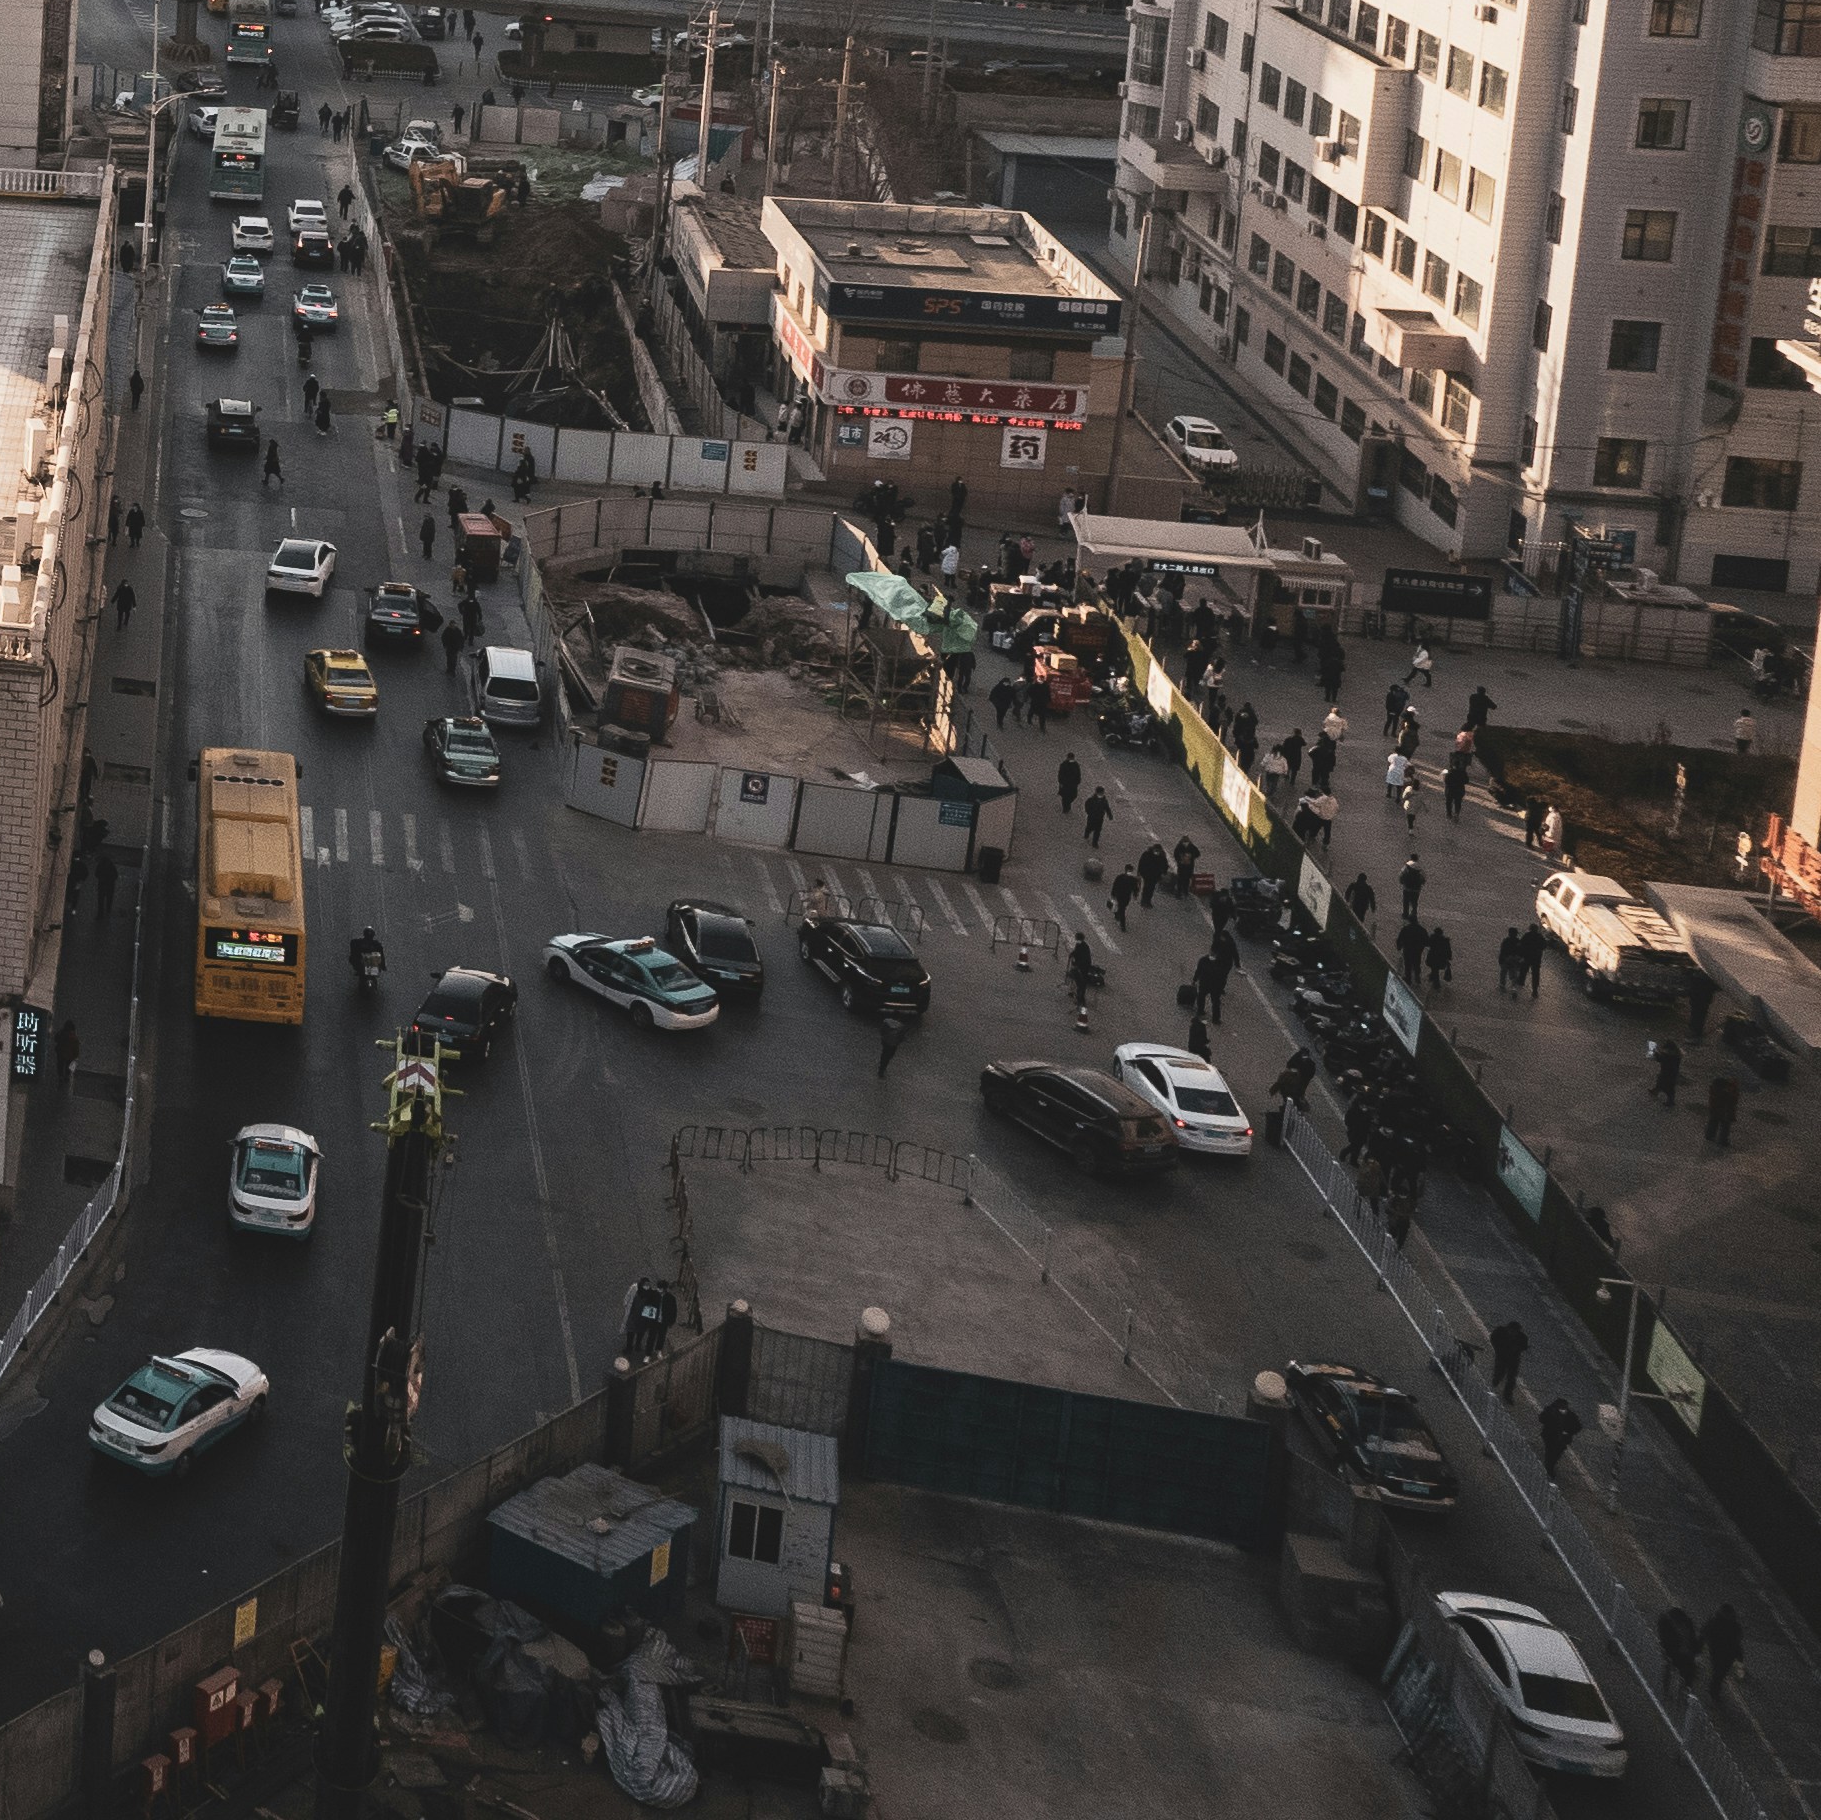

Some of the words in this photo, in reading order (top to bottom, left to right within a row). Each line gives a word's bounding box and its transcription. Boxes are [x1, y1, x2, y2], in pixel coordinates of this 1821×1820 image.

[838, 425, 862, 439] 超市
[1009, 435, 1040, 460] 药
[14, 1011, 40, 1076] 助听器
